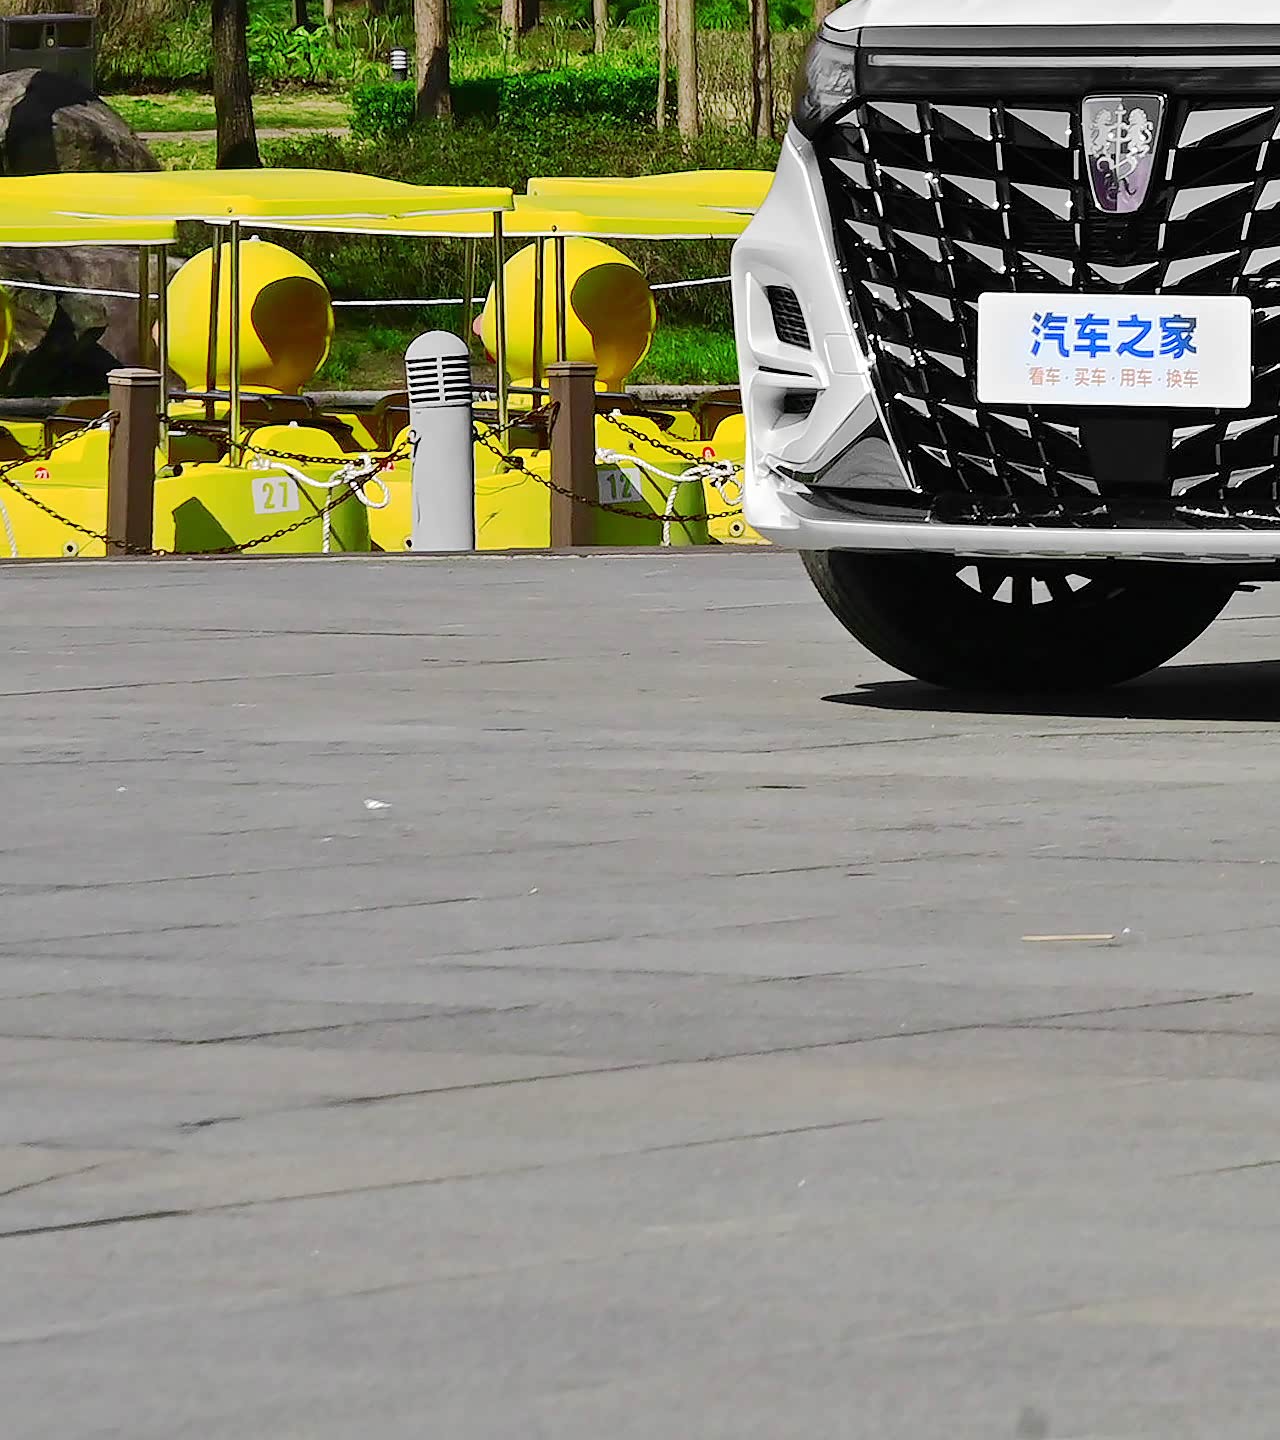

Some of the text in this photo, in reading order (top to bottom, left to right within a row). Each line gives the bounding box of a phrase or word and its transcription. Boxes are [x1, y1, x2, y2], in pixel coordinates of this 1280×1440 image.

[1031, 311, 1197, 359] 汽车之家
[262, 482, 288, 509] 27
[606, 473, 632, 499] 12
